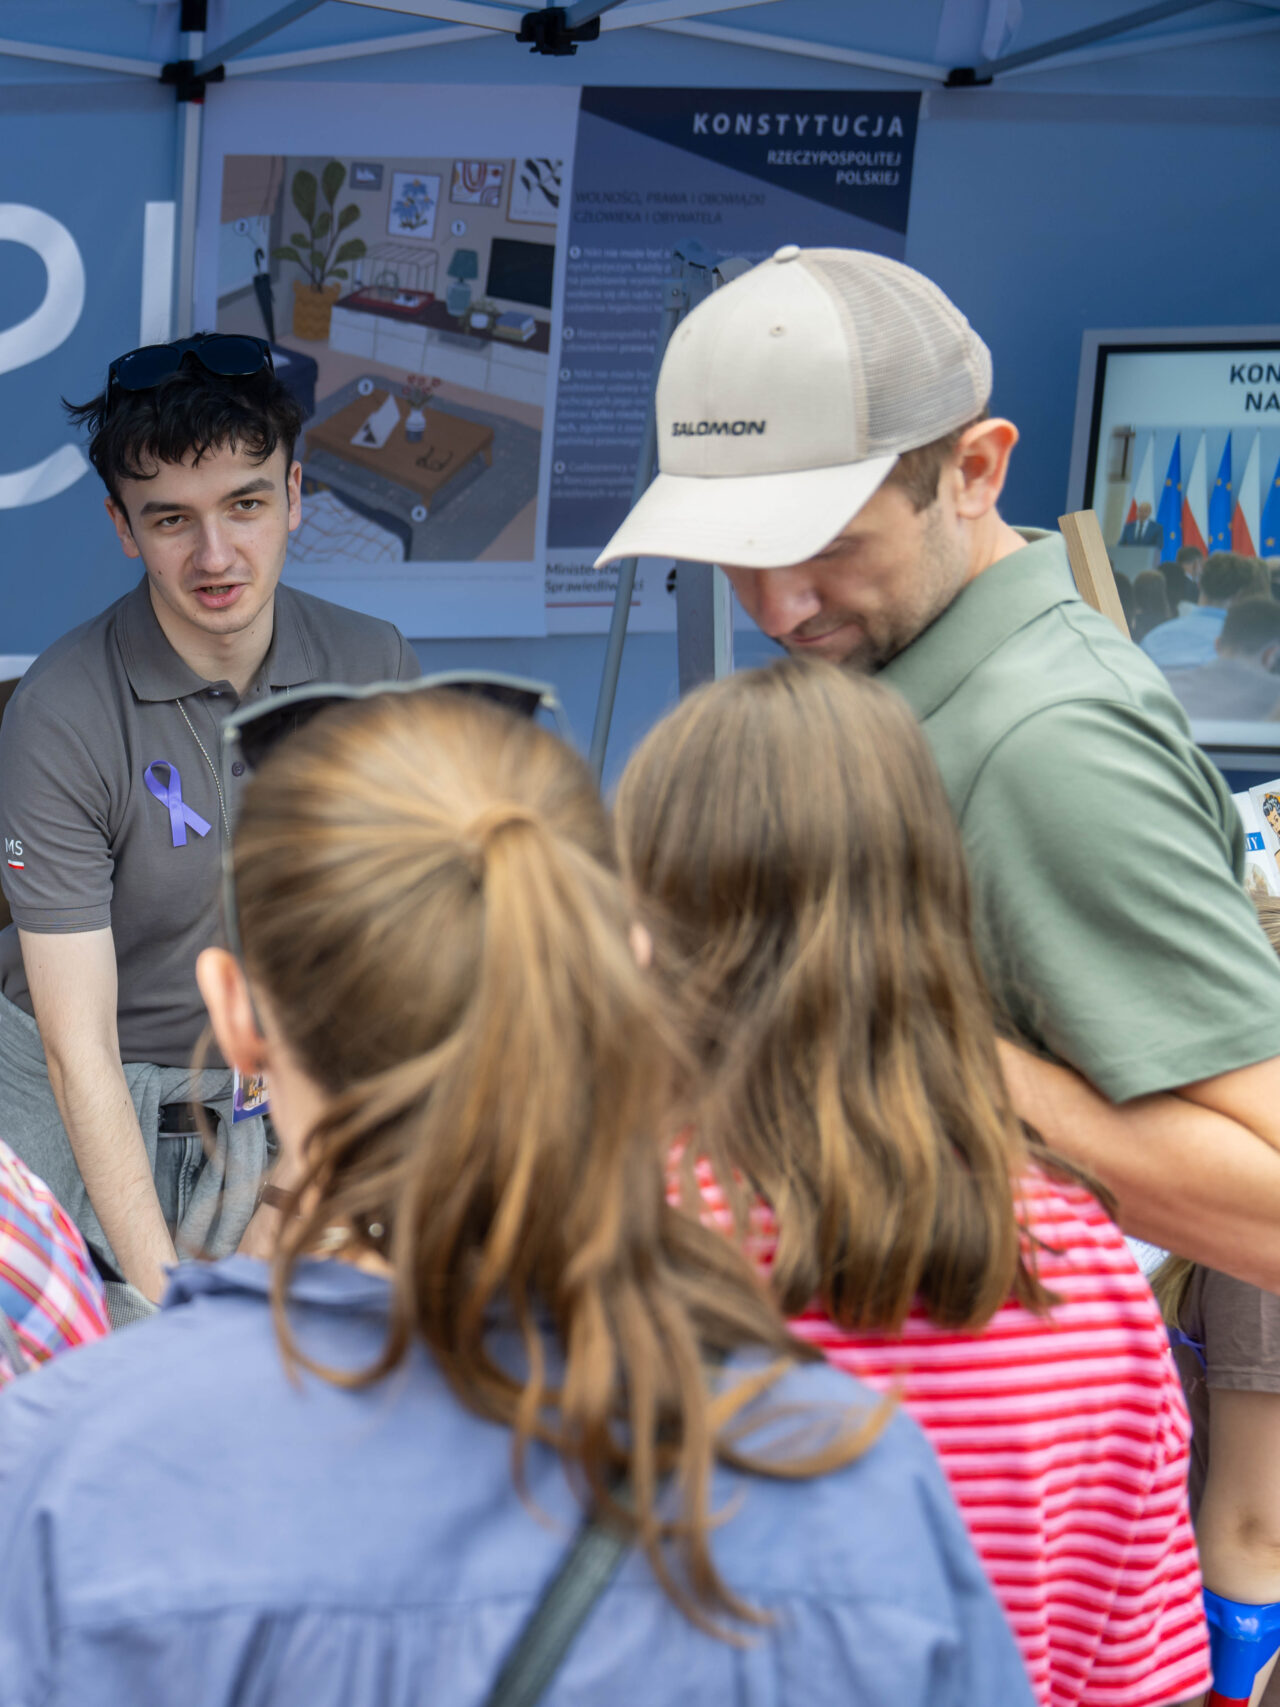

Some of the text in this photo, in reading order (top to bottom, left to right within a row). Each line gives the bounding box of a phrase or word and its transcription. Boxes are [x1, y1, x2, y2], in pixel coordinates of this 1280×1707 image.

[692, 112, 905, 138] KONSTYTUCJA
[767, 150, 902, 167] RZECZYPOSPOLITEJ
[835, 170, 900, 186] POLSKIEJ
[1230, 362, 1280, 385] KON
[1245, 391, 1280, 412] NA
[671, 419, 766, 437] SALOMON
[546, 562, 619, 576] Ministestw
[545, 577, 644, 593] Sprawiedliwci
[5, 837, 24, 856] MS
